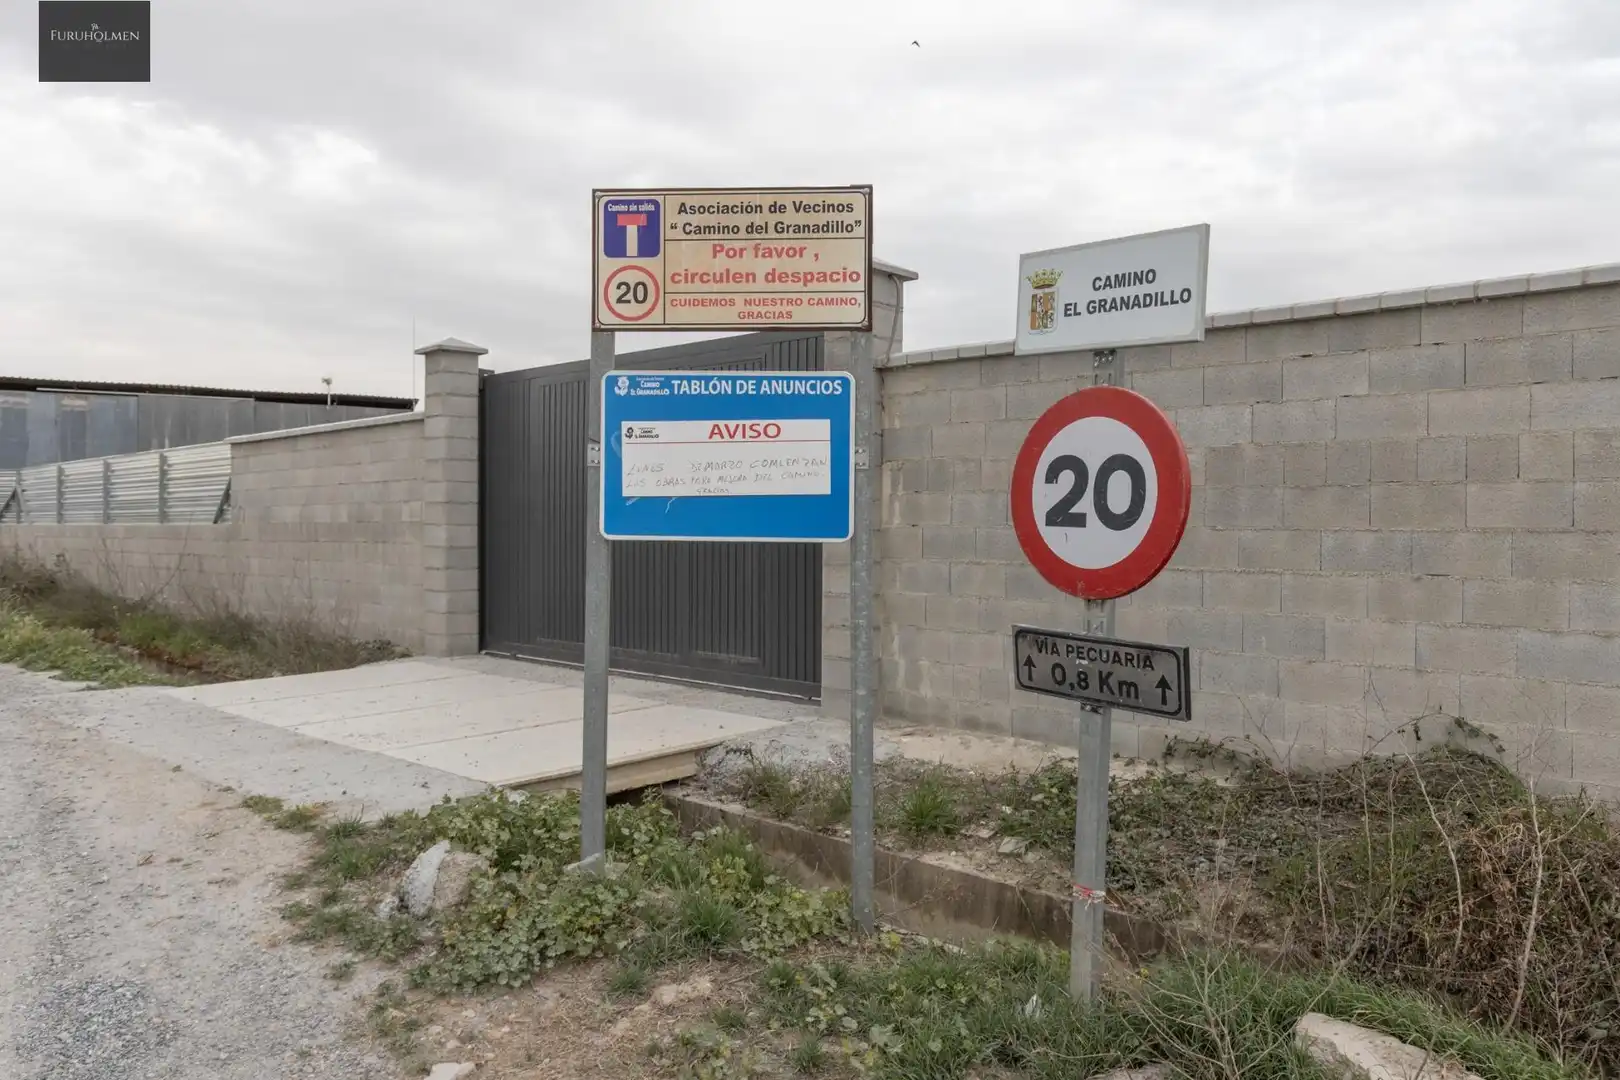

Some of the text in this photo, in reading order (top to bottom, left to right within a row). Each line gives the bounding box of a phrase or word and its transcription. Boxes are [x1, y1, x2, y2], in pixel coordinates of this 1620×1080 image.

[677, 200, 854, 215] Asociación de Vecinos
[745, 222, 769, 235] del
[711, 243, 747, 259] Por
[670, 267, 861, 288] circulen despacio
[1092, 268, 1157, 292] CAMINO
[615, 281, 649, 305] 20
[670, 297, 861, 308] CUIDEMOS NUESTRO CAMINO,
[1063, 288, 1192, 318] EL GRANADILLO
[737, 310, 793, 320] GRACIAS
[671, 377, 843, 395] TABLÓN DE ANUNCIOS
[708, 423, 782, 440] AVISO
[1044, 453, 1147, 532] 20
[1066, 643, 1155, 671] PECUARIA
[1051, 662, 1140, 700] 0,8 Km
